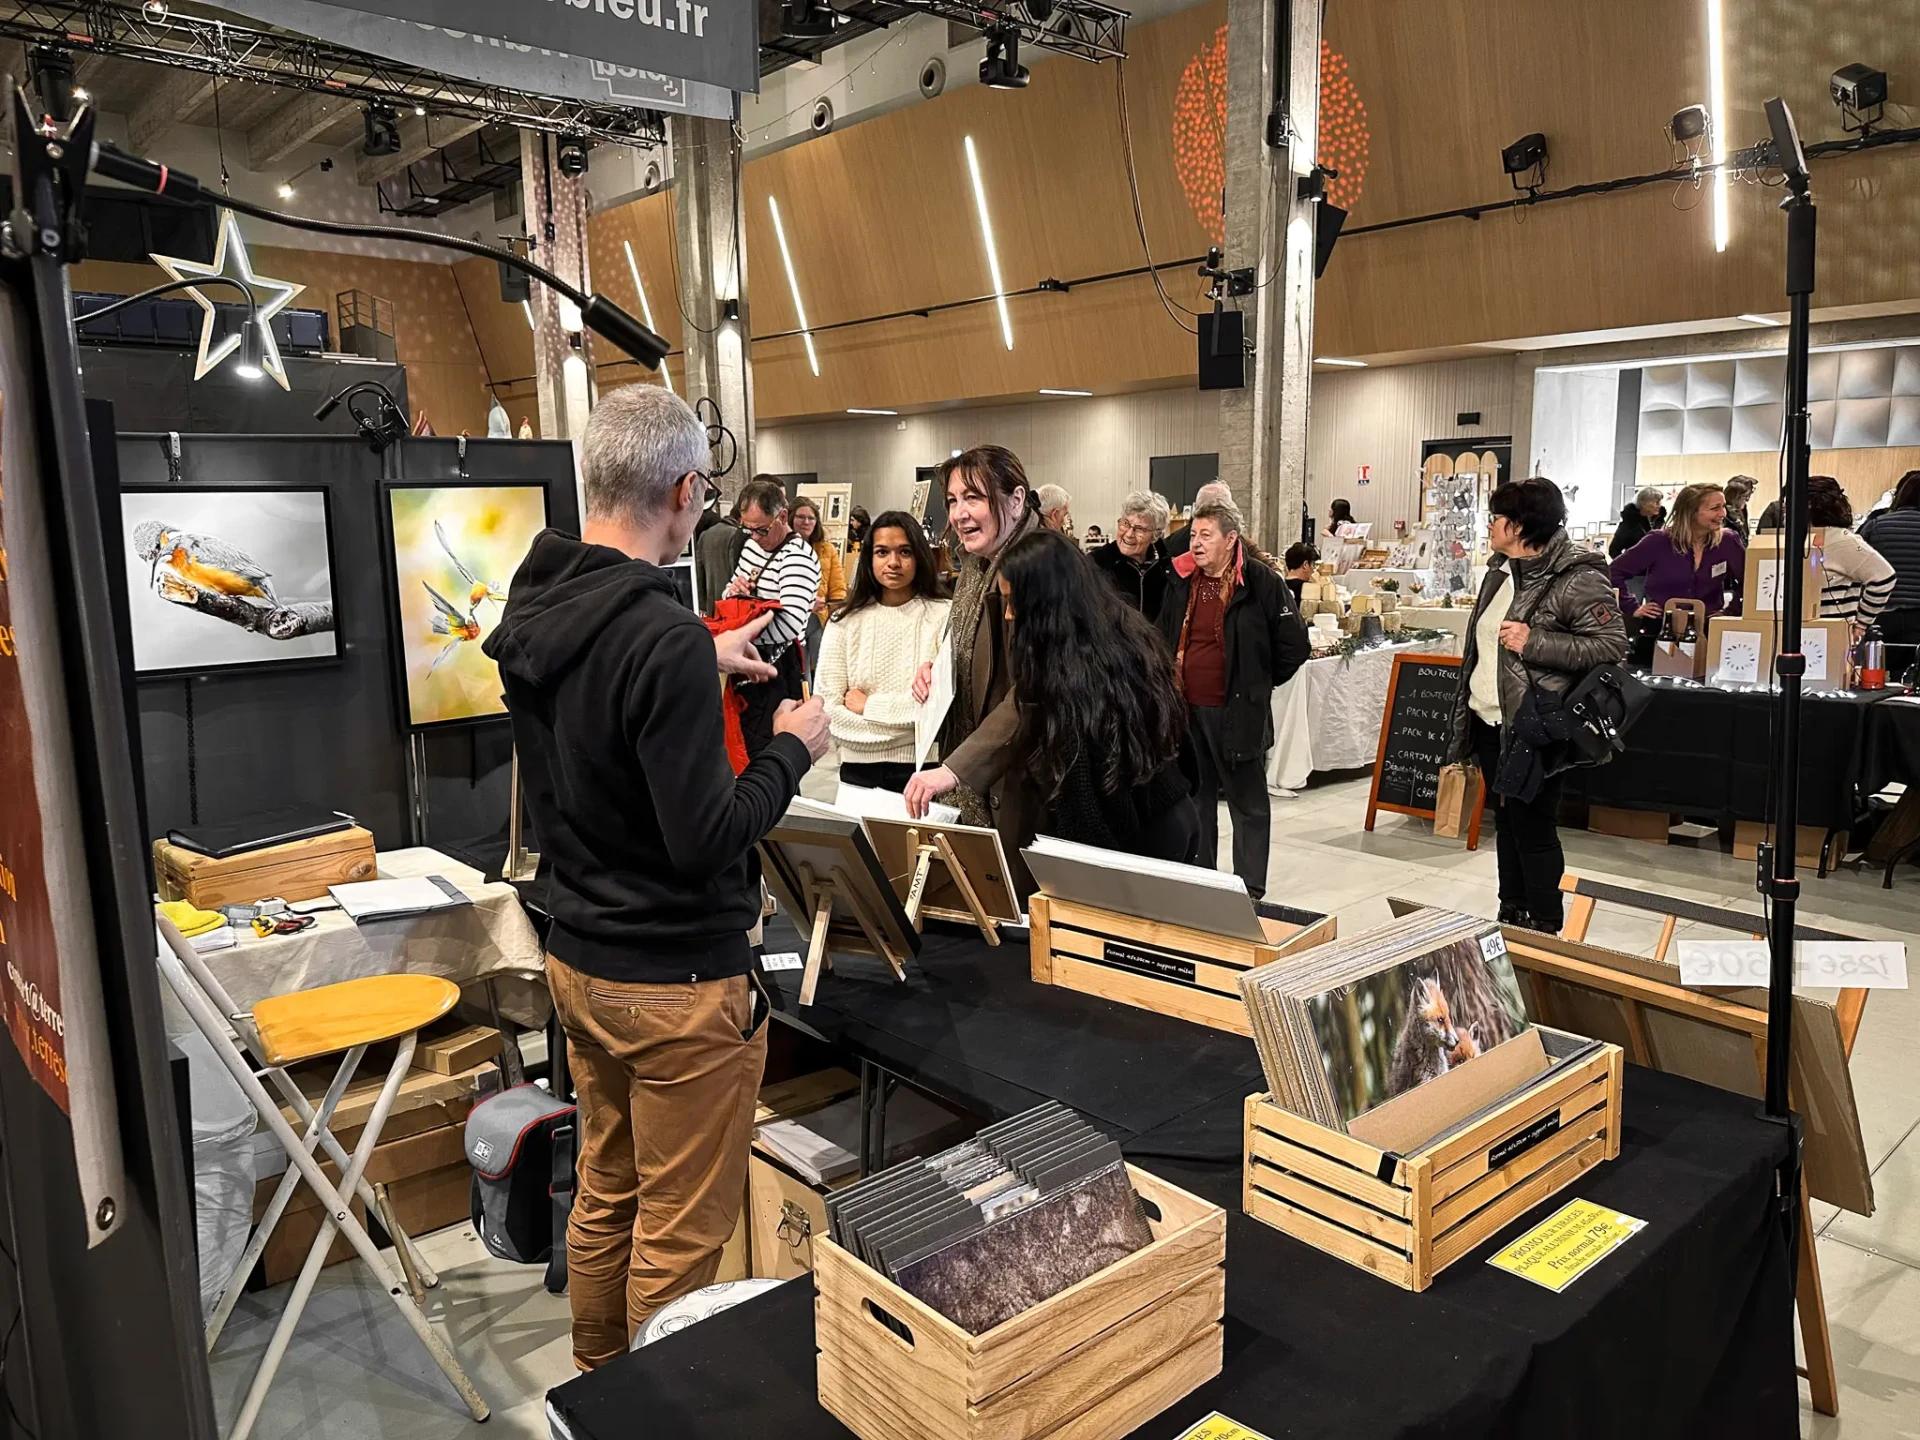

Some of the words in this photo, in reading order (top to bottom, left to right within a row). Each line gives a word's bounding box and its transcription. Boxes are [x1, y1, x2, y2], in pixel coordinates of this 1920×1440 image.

[1406, 706, 1429, 719] PACK
[1402, 726, 1422, 737] PACK
[1397, 750, 1432, 763] CARTON
[1509, 1236, 1544, 1260] PROMO
[1547, 1255, 1571, 1270] Prix
[1568, 1234, 1596, 1257] normal
[1587, 1222, 1613, 1238] 79€
